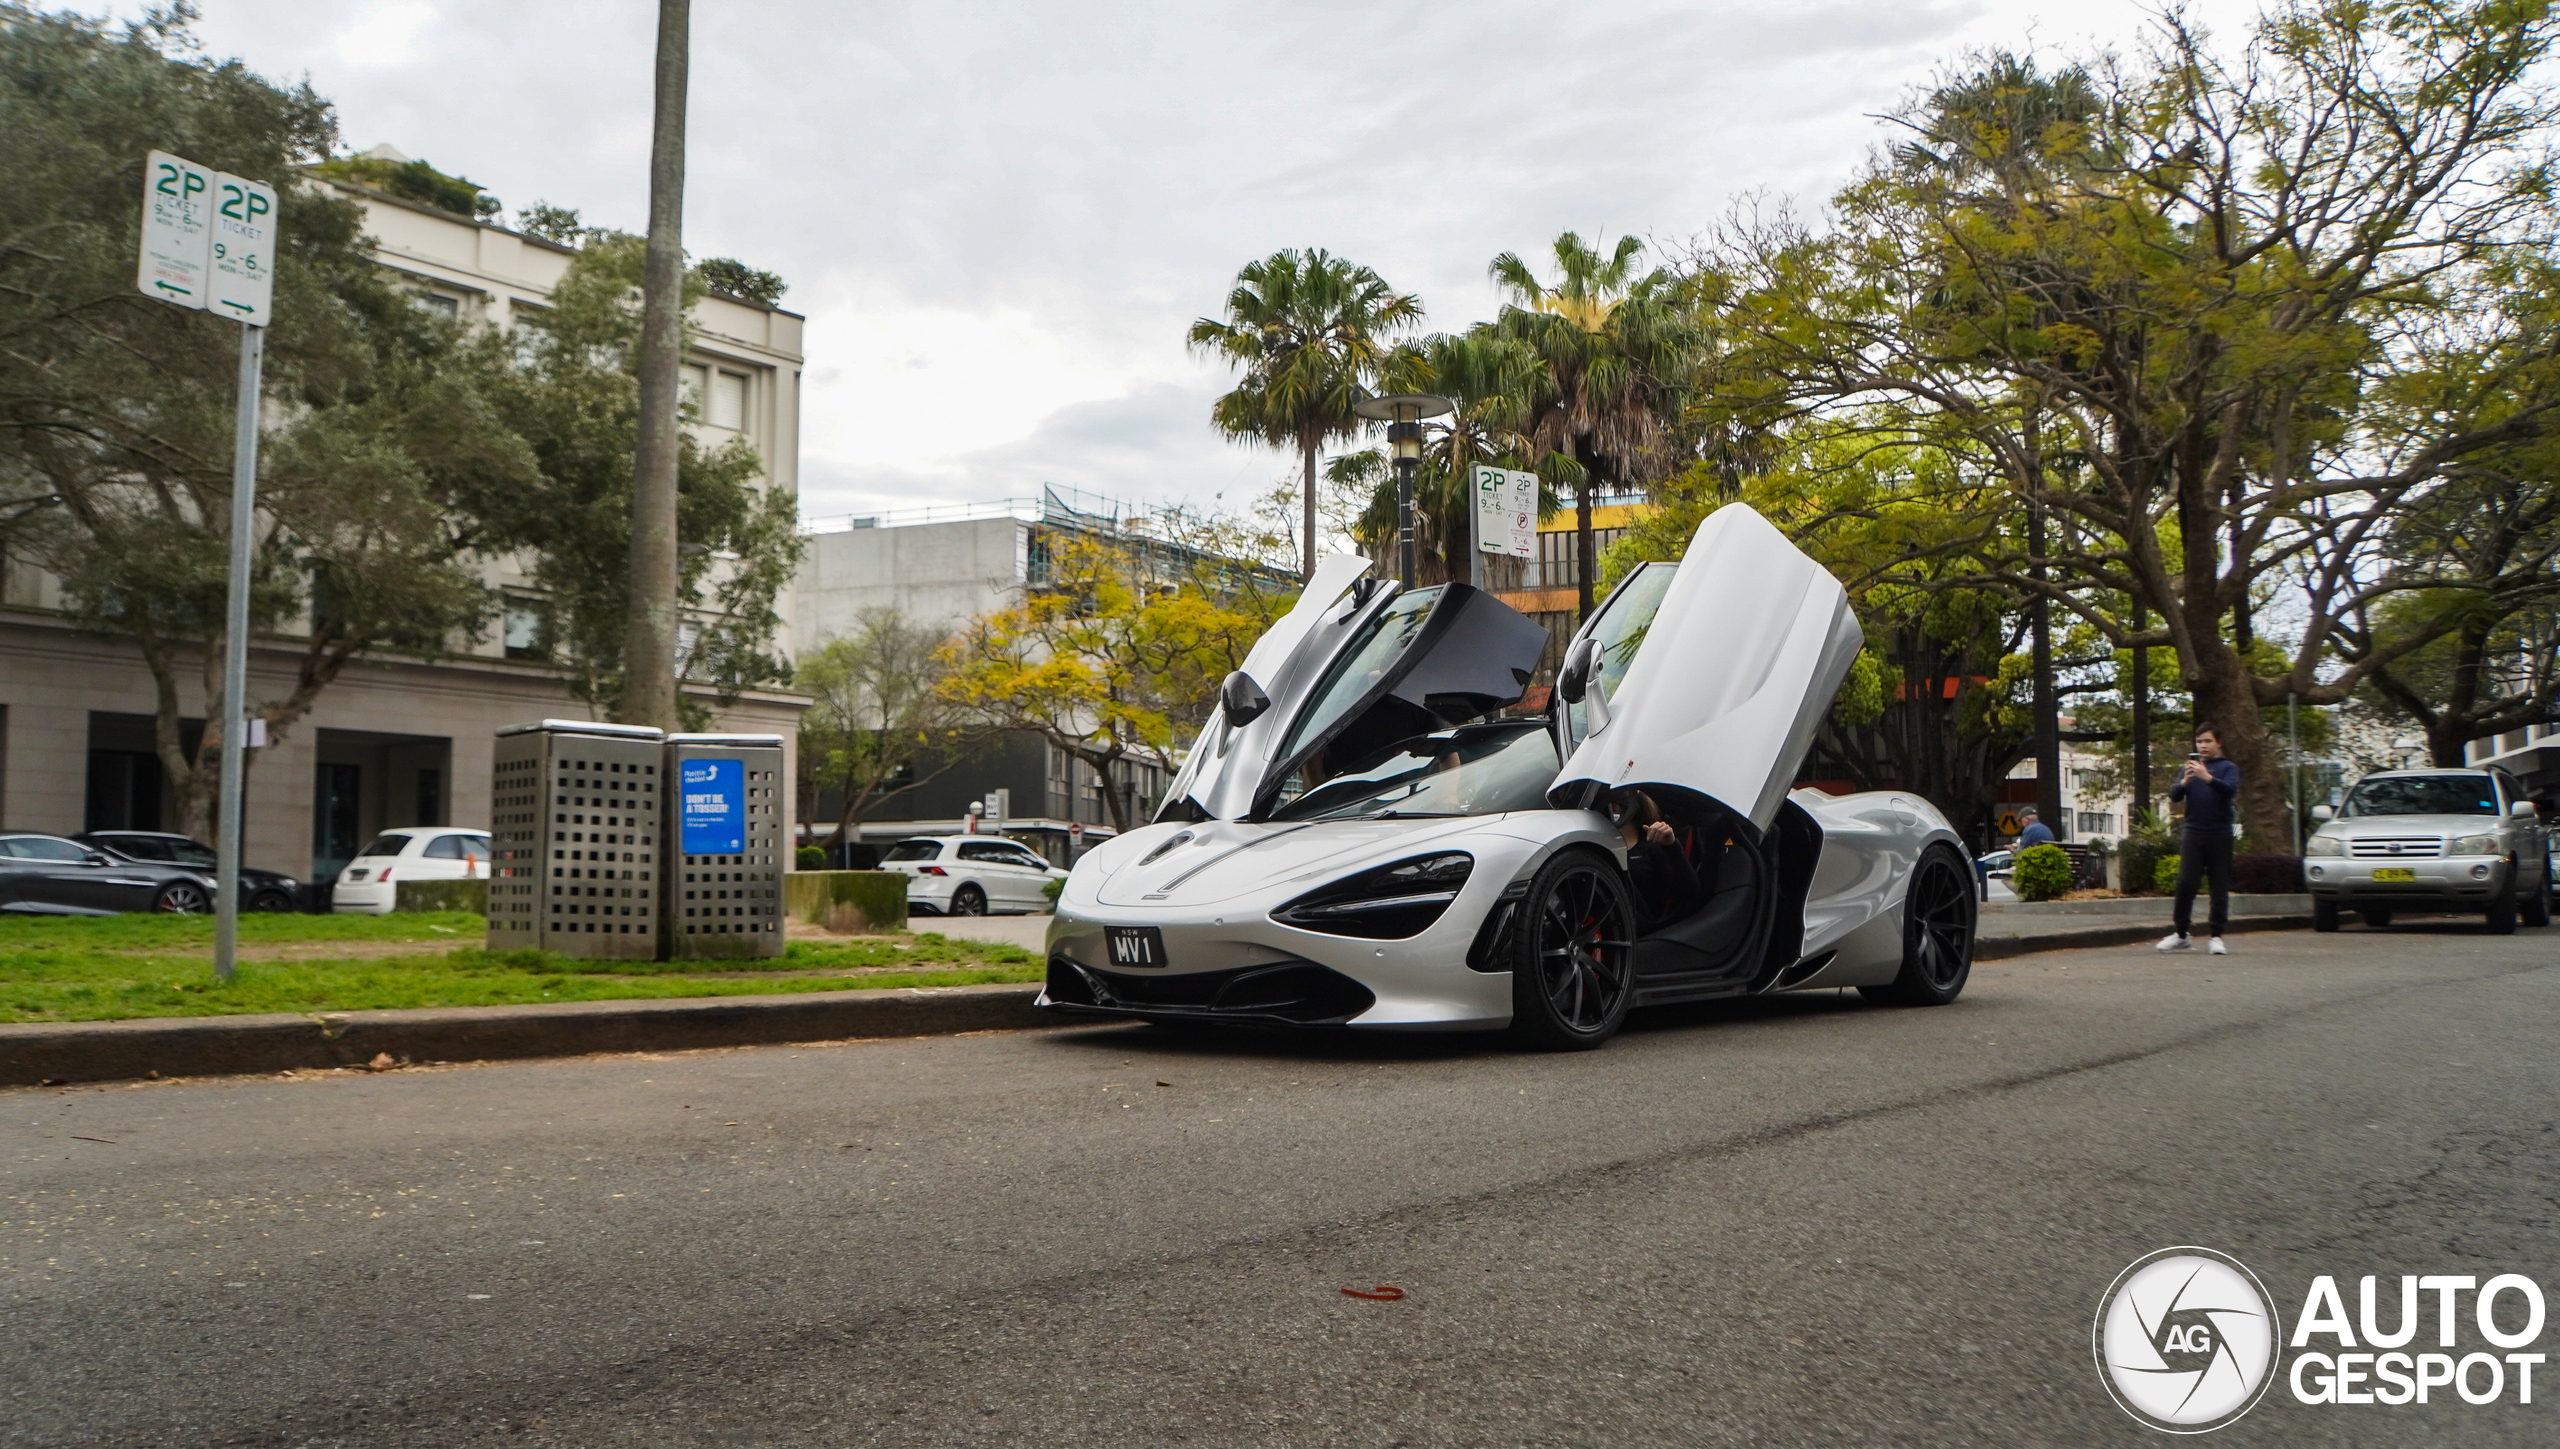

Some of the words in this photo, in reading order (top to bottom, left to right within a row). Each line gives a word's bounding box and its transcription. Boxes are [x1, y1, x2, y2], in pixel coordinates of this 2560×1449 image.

[157, 163, 205, 200] 2P
[156, 192, 199, 215] TICKET
[220, 184, 269, 223] 2P
[222, 218, 262, 241] TICKET
[246, 271, 262, 281] SAT
[1480, 471, 1505, 492] 2P
[1516, 479, 1531, 491] 2P
[1483, 491, 1503, 501] TICKET
[686, 794, 712, 804] DON'T
[712, 794, 724, 804] BE
[686, 804, 693, 813] A
[693, 804, 729, 813] TOSSER!
